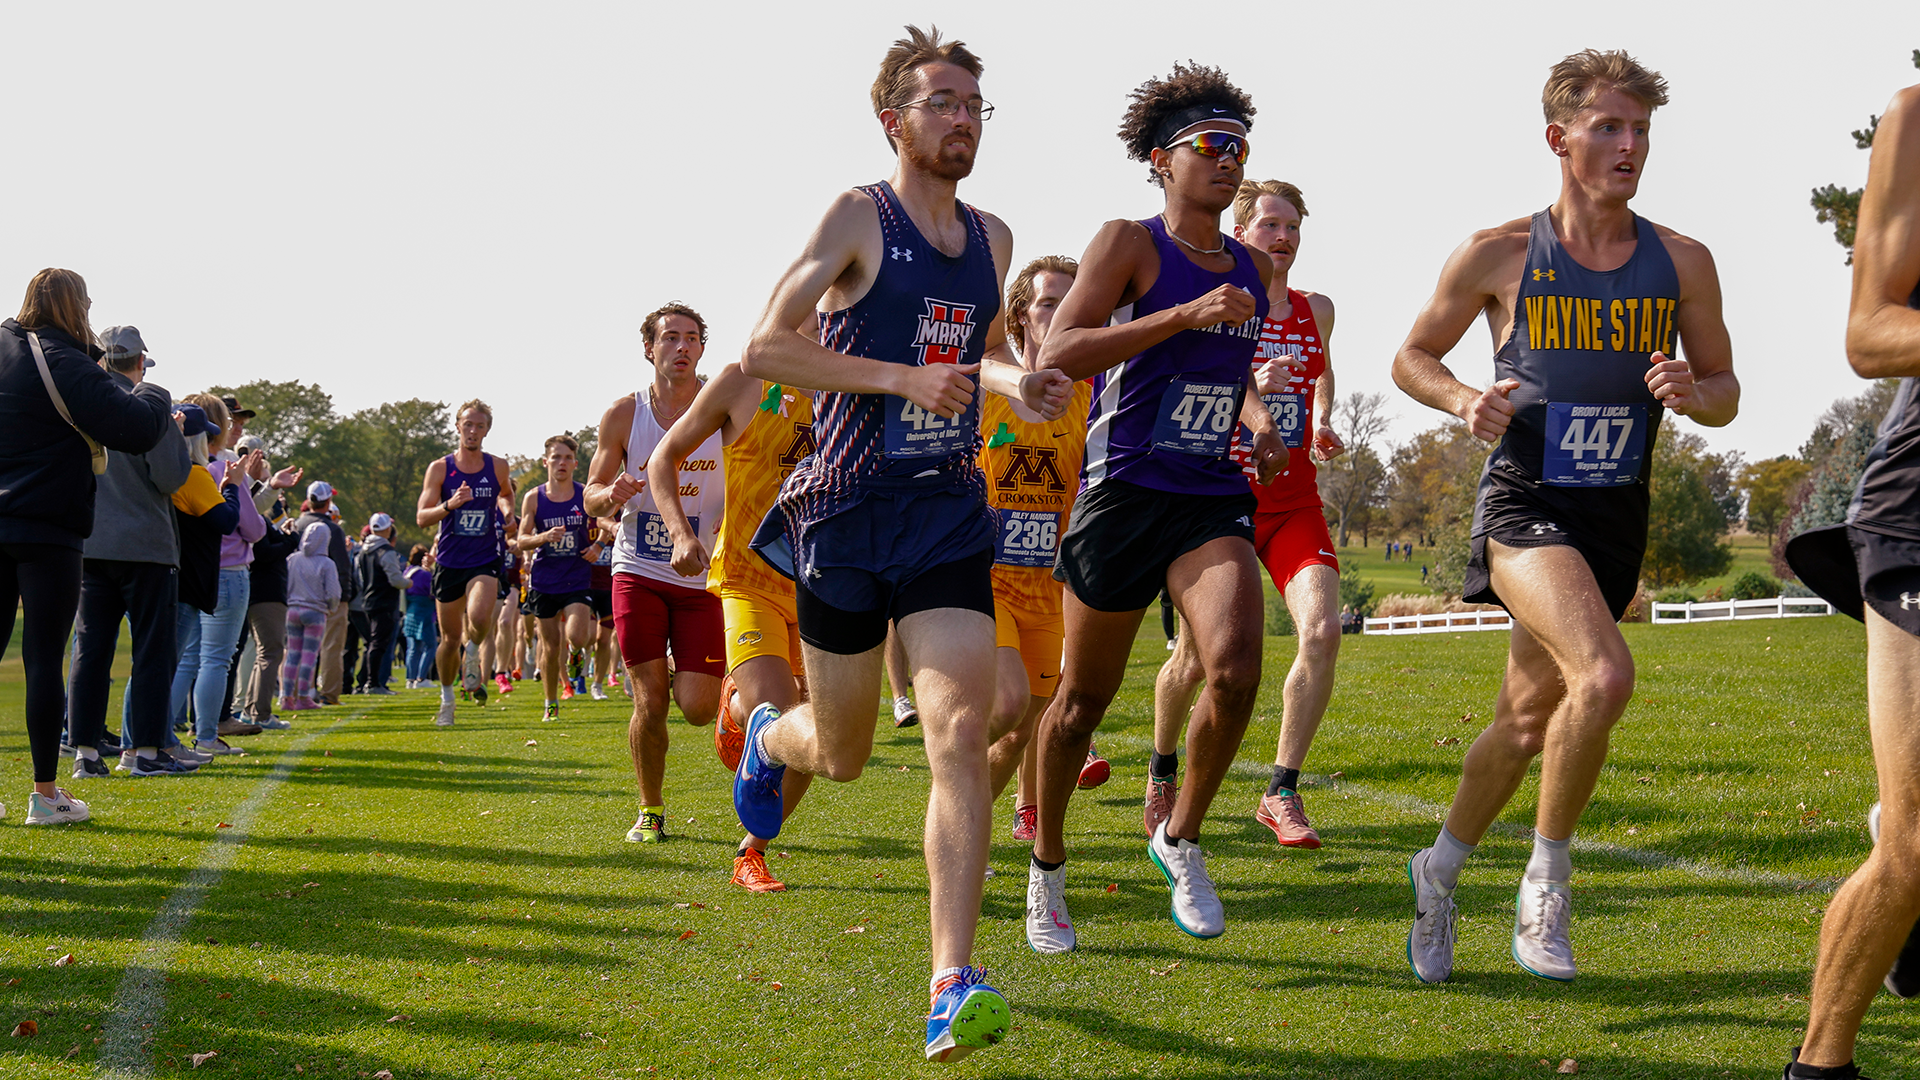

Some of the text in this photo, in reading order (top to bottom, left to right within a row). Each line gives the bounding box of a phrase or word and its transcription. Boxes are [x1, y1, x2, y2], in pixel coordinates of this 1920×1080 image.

[1524, 295, 1676, 355] WAYNE STATE
[918, 318, 972, 349] MARY
[1183, 384, 1234, 396] ROBERT SPAIN
[1170, 394, 1234, 433] 478
[1264, 402, 1299, 430] 23
[1571, 406, 1631, 417] BRODY LUCAS
[906, 429, 961, 442] University of Mary
[1180, 431, 1219, 441] Winona State
[1560, 418, 1634, 460] 447
[995, 445, 1067, 493] M
[1575, 461, 1618, 471] Wayne State
[475, 487, 492, 498] STATE
[998, 492, 1065, 505] CROOKSTON
[459, 514, 486, 528] 477
[566, 515, 583, 526] STATE
[1011, 511, 1056, 521] RILEY HANSON
[644, 521, 674, 547] 33
[1003, 519, 1058, 550] 236
[1003, 548, 1030, 556] Minnesota
[56, 805, 71, 813] HOKA
